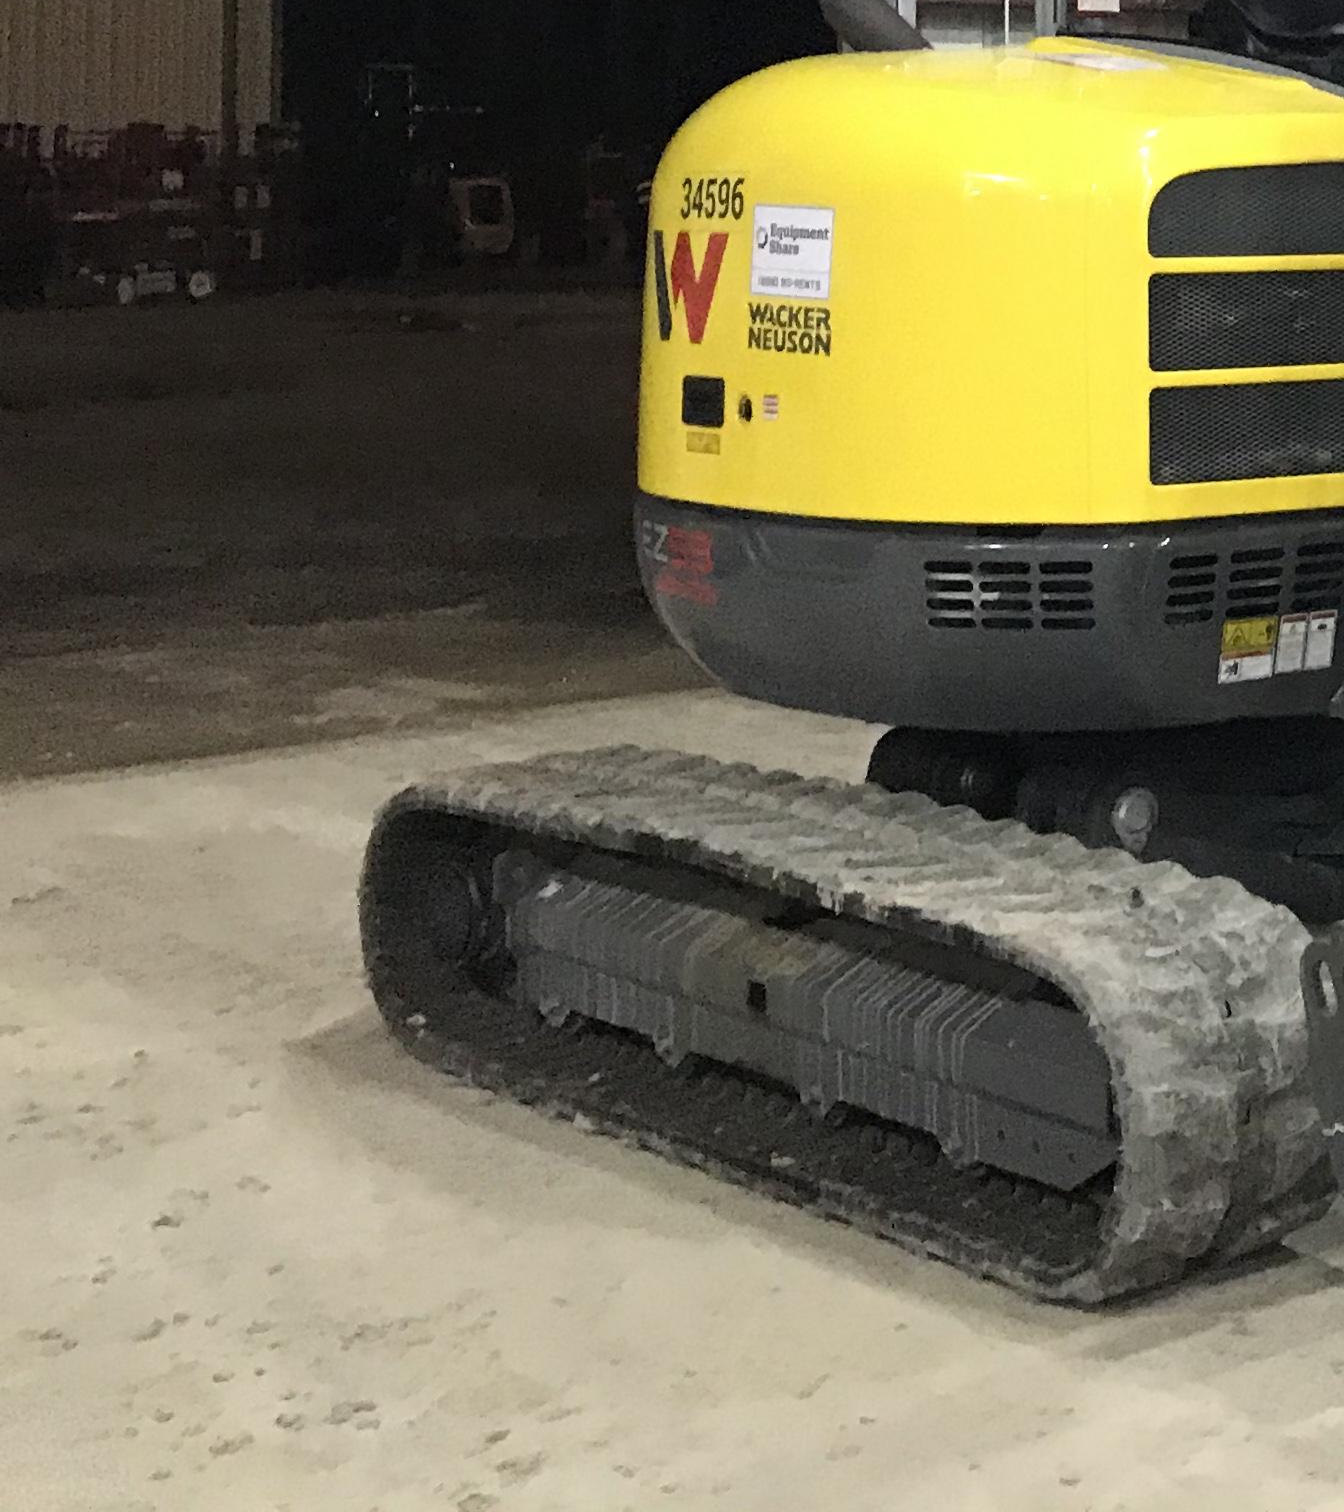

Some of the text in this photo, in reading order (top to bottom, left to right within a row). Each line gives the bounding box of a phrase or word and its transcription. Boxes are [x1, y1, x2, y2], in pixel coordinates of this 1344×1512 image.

[680, 177, 745, 220] 34596
[769, 222, 830, 241] Equipment
[768, 239, 800, 256] Share
[747, 302, 832, 332] WACKER
[747, 326, 832, 358] NEUSON
